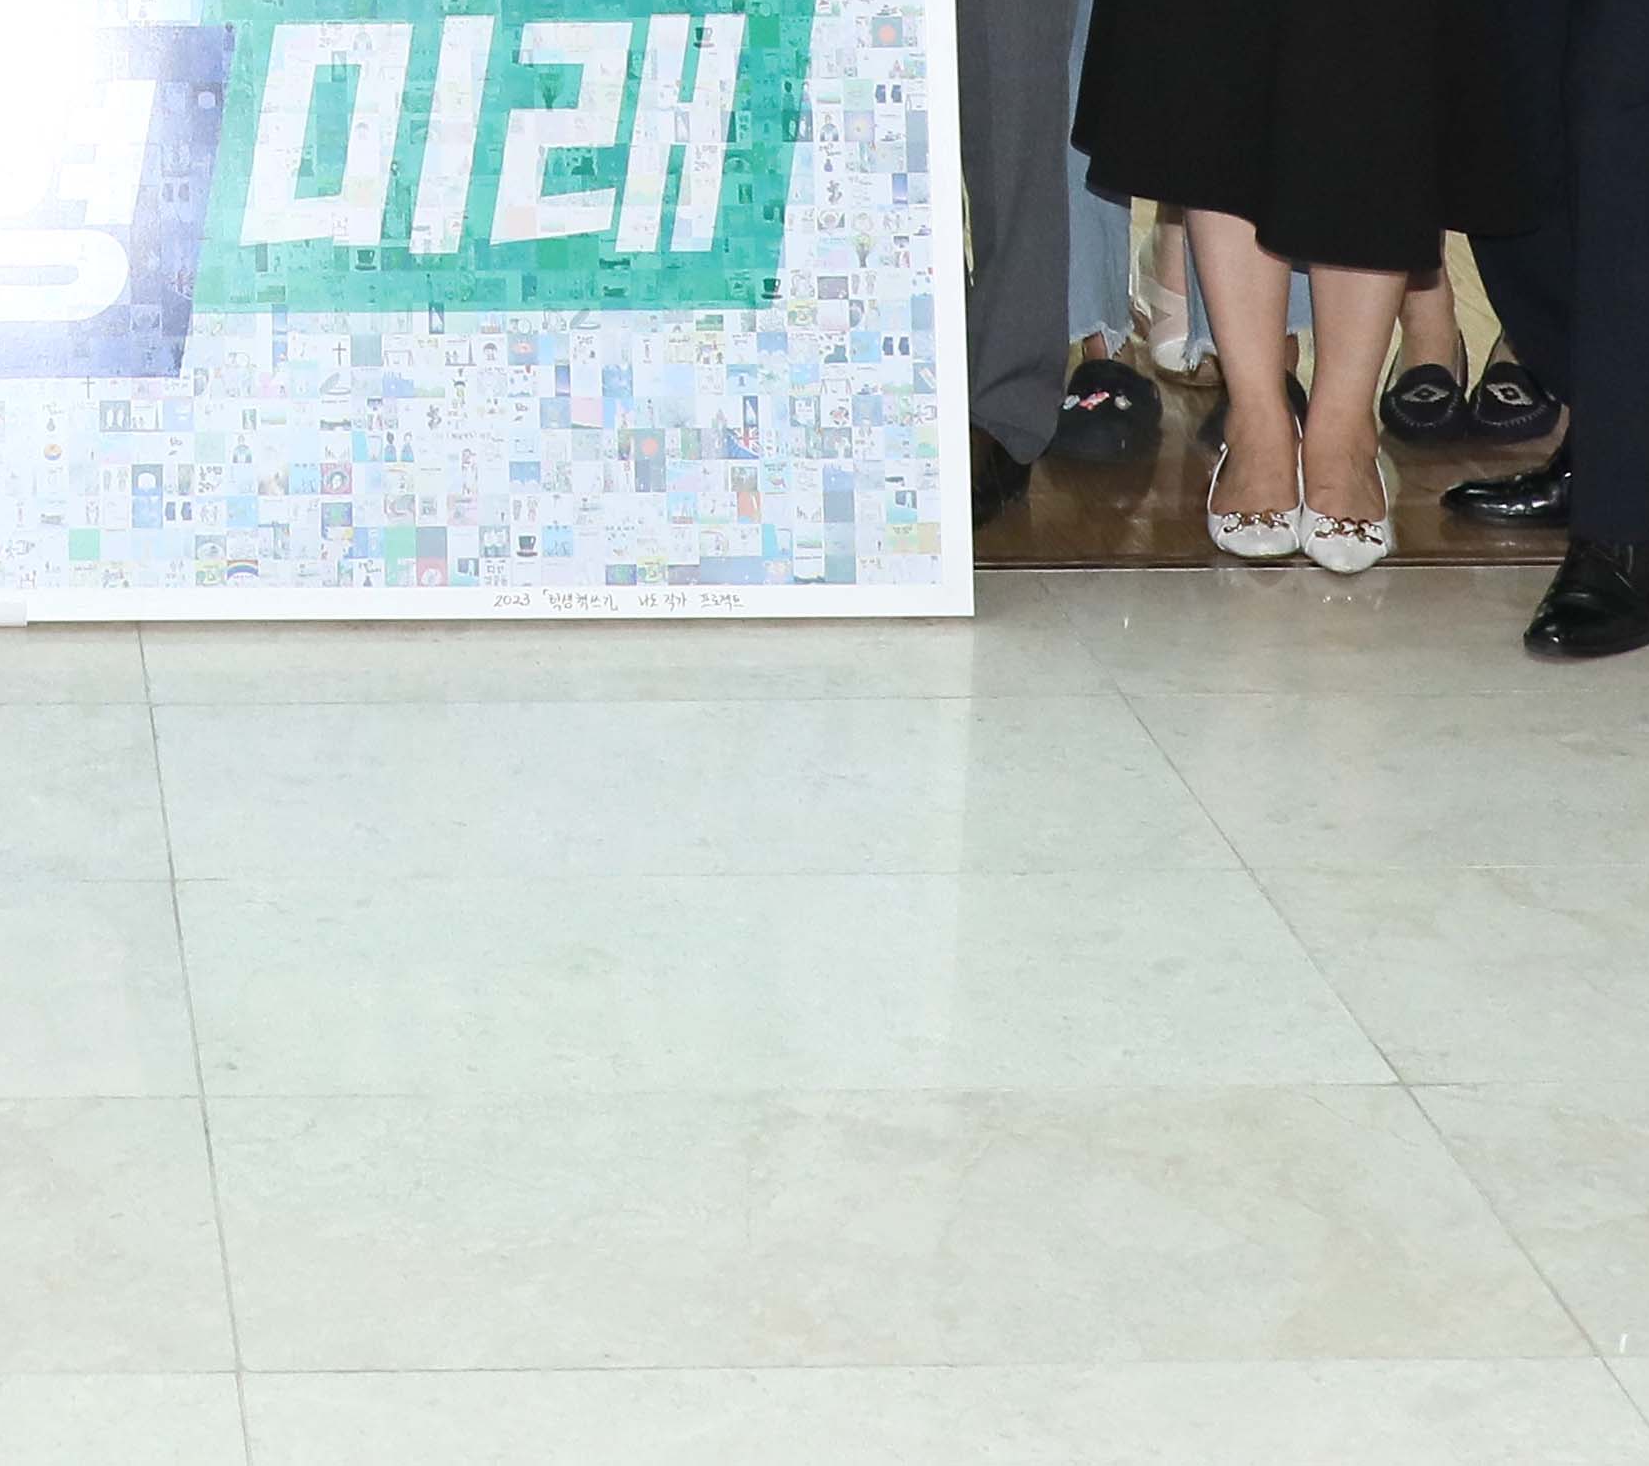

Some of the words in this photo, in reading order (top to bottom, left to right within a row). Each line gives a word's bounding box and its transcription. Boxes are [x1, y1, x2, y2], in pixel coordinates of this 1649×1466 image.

[239, 13, 746, 255] 미래
[494, 592, 531, 608] 2023
[700, 593, 746, 610] 프로젝트
